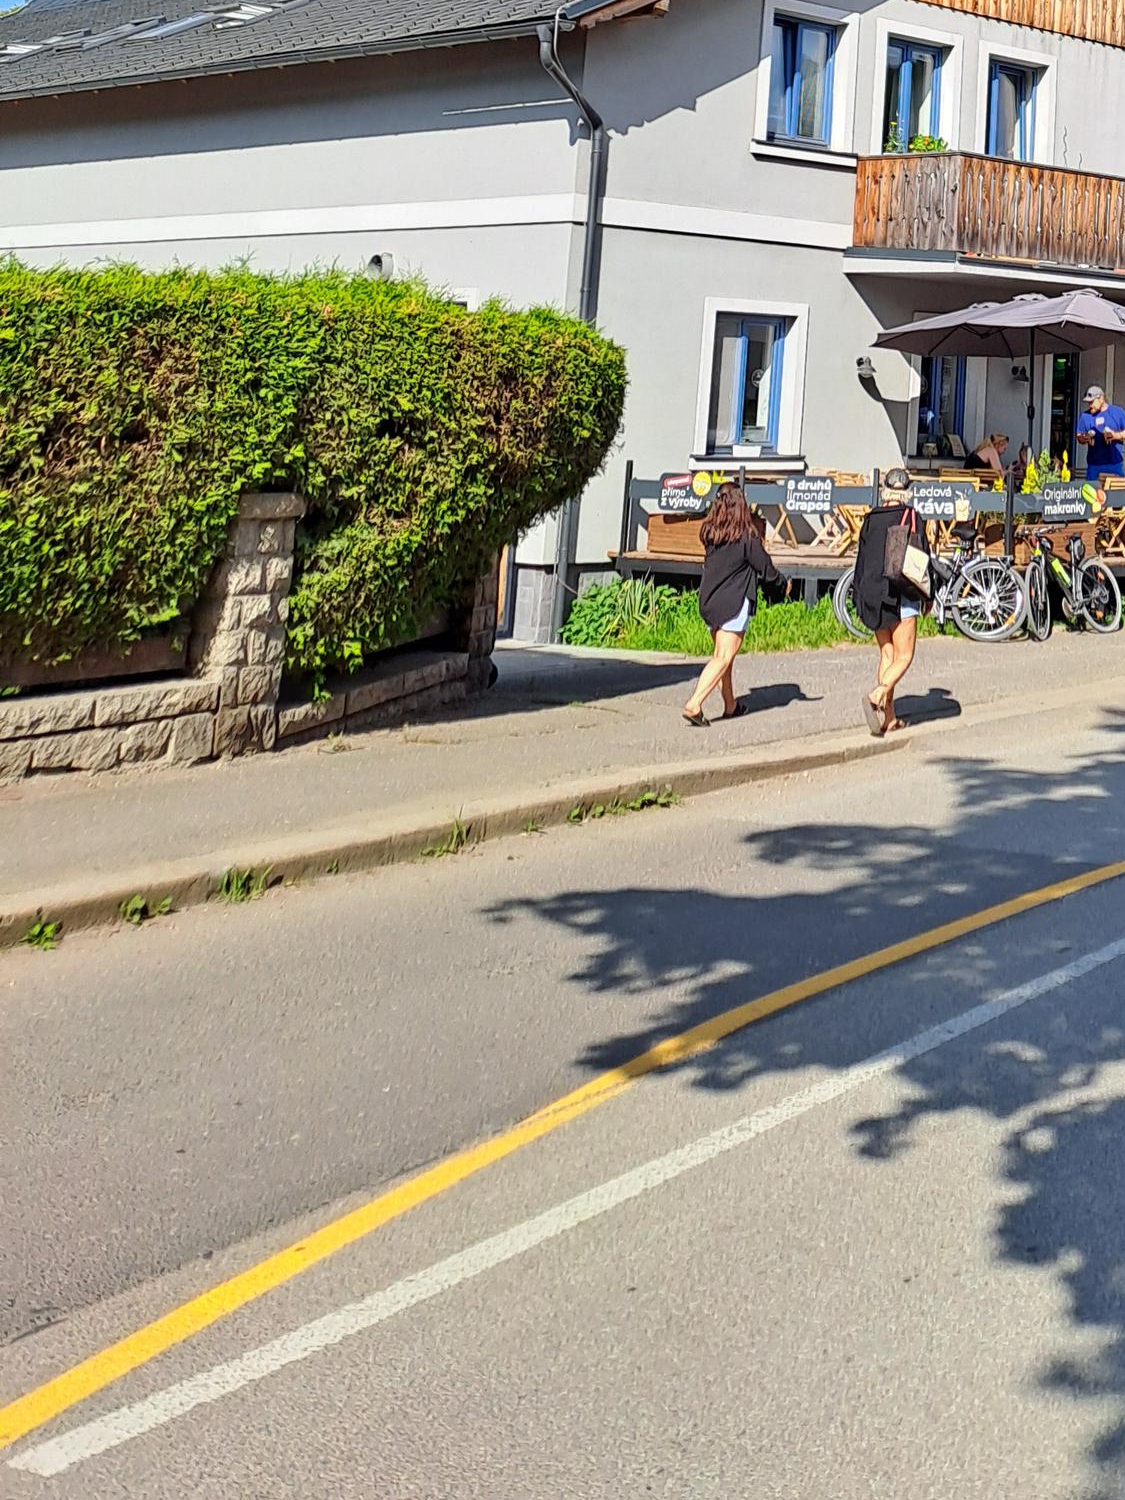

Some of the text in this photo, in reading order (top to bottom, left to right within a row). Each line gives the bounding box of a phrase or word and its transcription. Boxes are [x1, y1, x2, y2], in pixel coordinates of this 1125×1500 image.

[913, 485, 952, 497] Ledová
[660, 497, 667, 506] z
[913, 498, 954, 515] káva
[1044, 500, 1086, 516] makronky
